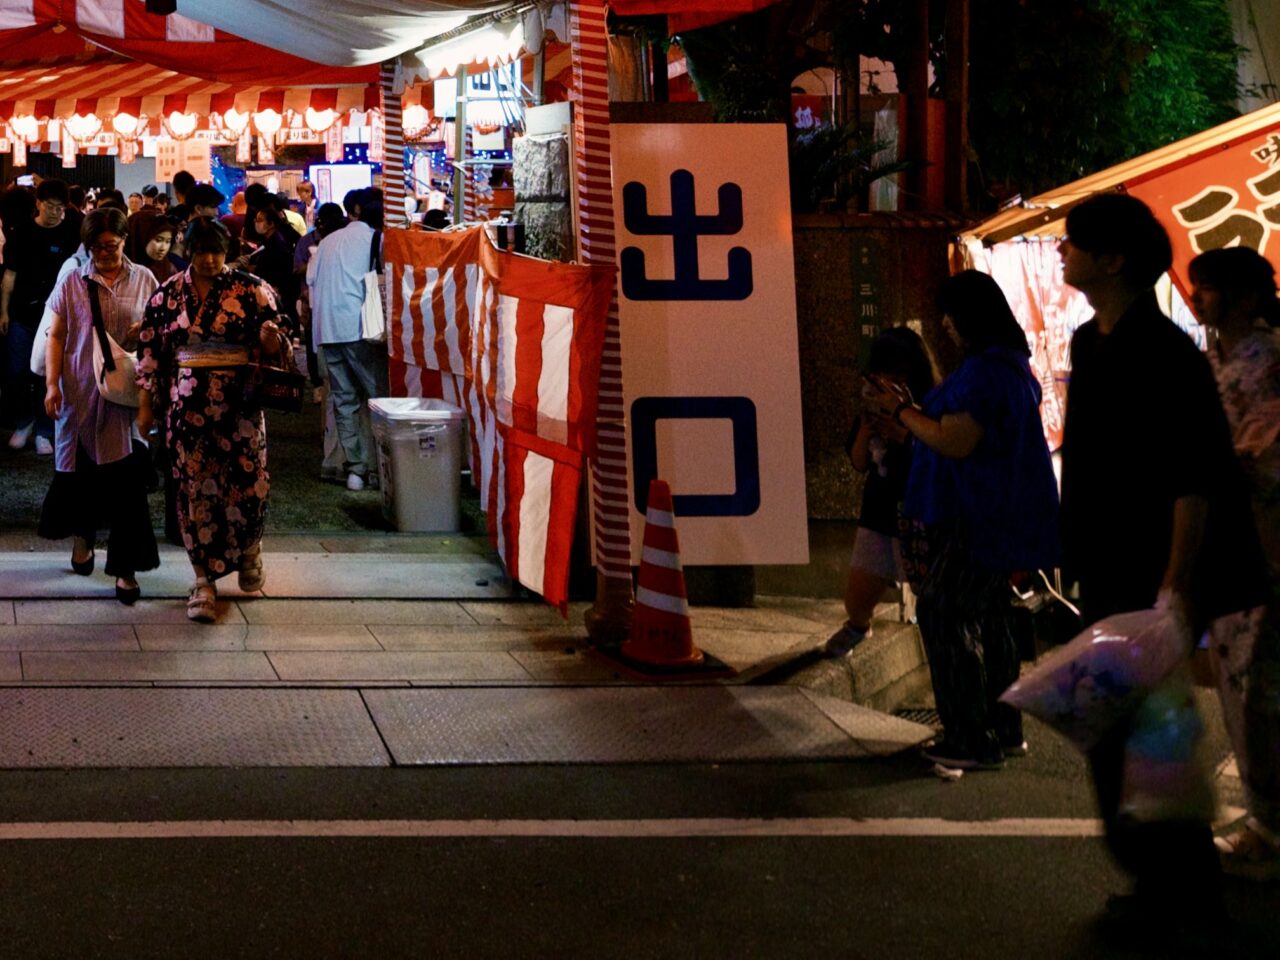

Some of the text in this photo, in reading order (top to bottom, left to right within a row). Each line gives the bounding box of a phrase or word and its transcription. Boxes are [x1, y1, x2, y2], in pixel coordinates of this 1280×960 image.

[620, 169, 761, 517] 出口
[859, 283, 875, 337] 三川町
